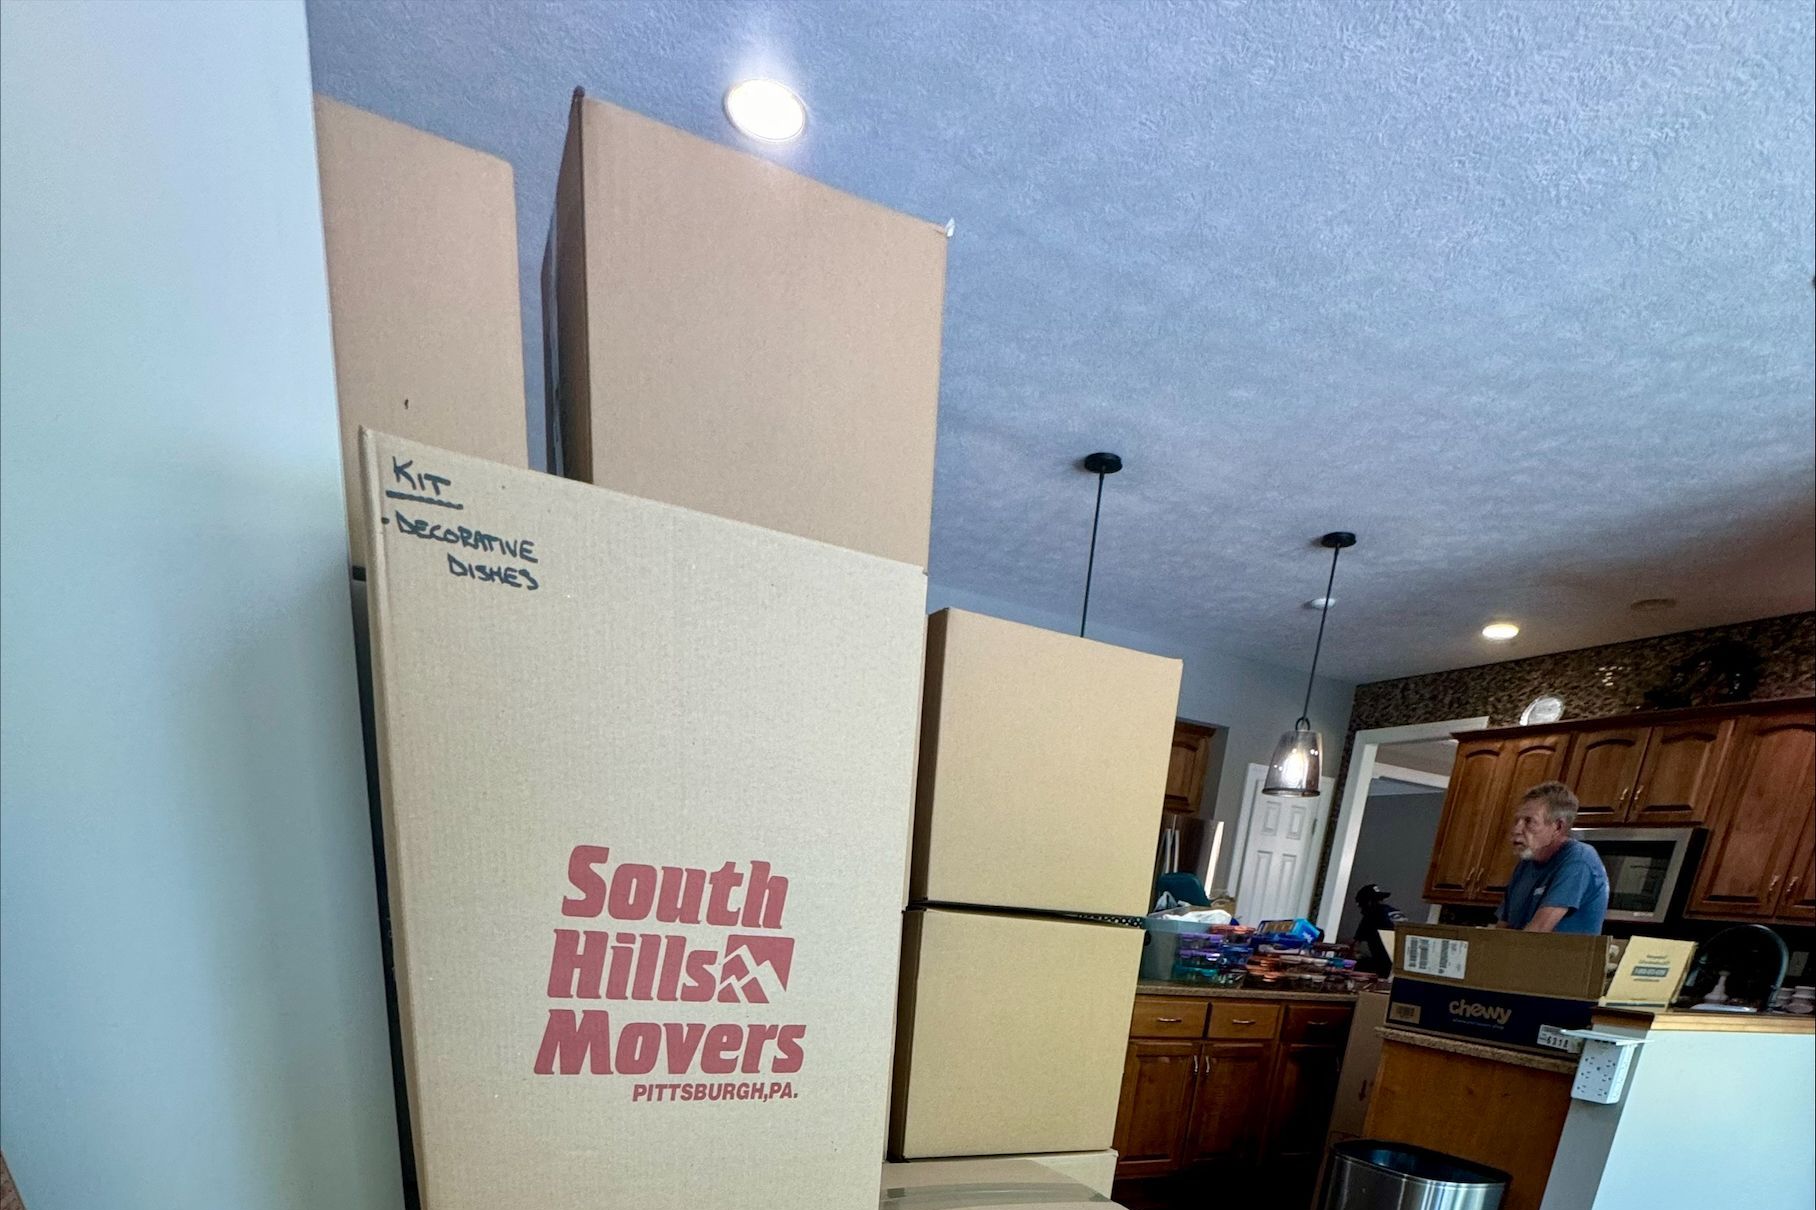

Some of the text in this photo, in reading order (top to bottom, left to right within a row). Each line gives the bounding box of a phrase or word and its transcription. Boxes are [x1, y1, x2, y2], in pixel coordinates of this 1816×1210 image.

[392, 456, 452, 496] KIT
[395, 510, 539, 563] DECORATIVE
[447, 552, 540, 591] DISHES
[561, 844, 789, 929] South
[547, 928, 718, 1003] Hills
[1449, 999, 1512, 1025] chewy
[533, 1008, 807, 1075] Movers
